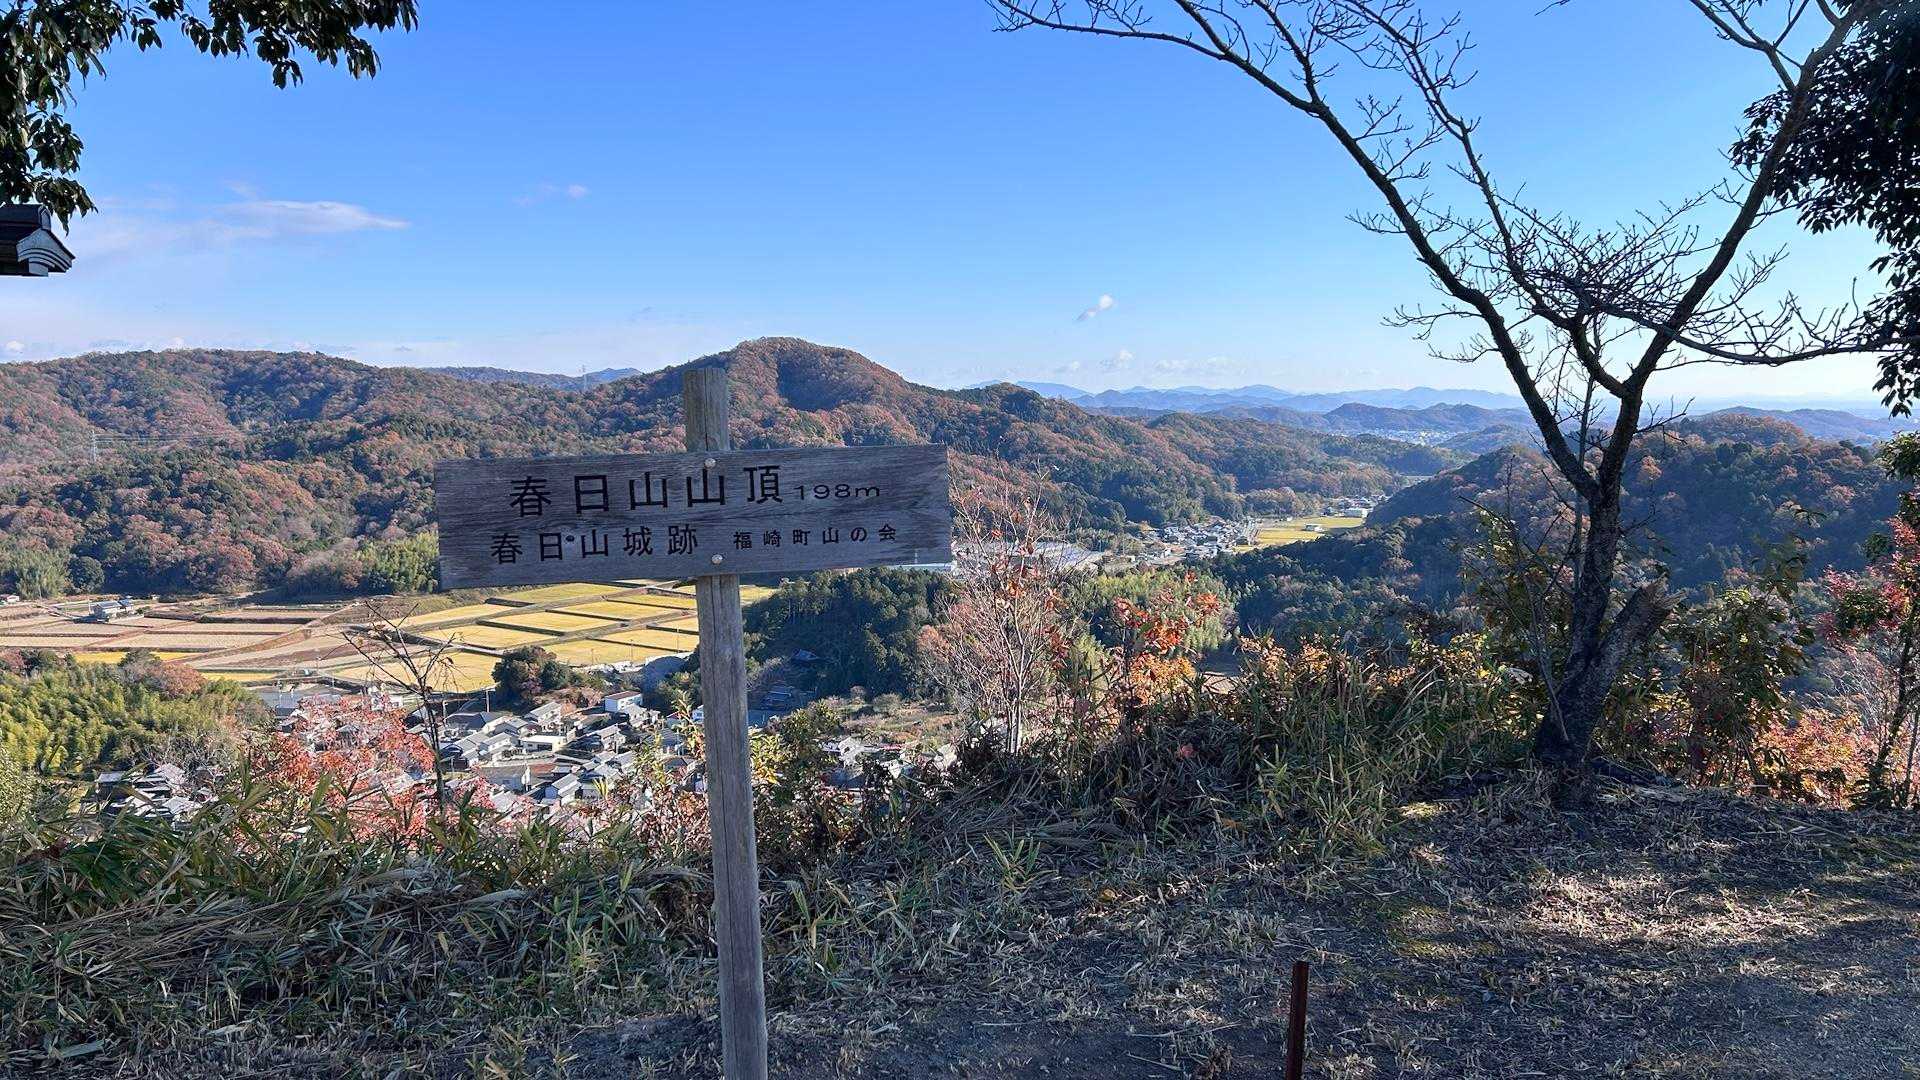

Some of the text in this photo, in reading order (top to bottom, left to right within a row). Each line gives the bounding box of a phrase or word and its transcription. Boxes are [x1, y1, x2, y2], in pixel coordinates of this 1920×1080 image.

[509, 465, 881, 518] 春日山山頂 198m
